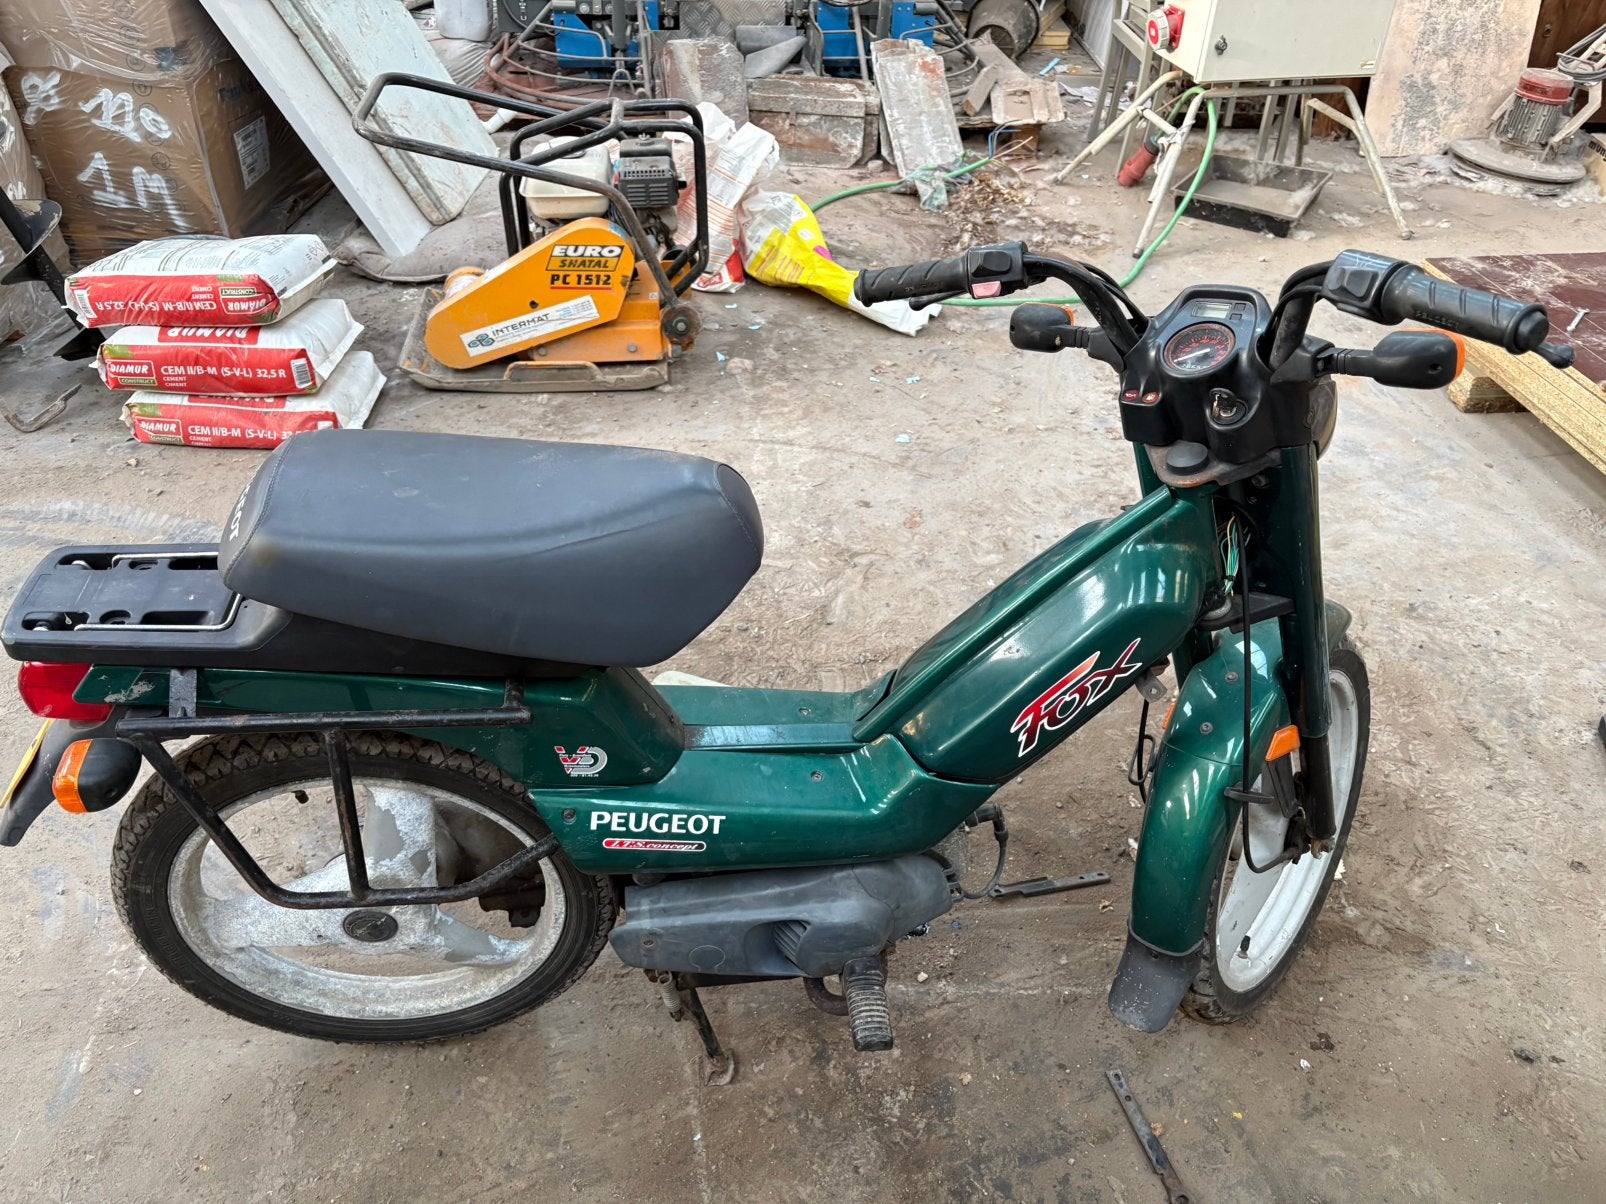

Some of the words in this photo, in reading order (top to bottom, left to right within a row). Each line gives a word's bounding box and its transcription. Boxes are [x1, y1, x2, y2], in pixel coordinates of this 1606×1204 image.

[551, 245, 622, 257] EURO
[558, 259, 609, 268] SHATAL
[550, 274, 570, 285] PC
[577, 274, 611, 285] 1512
[95, 301, 105, 311] R
[193, 301, 217, 311] CEM
[227, 298, 267, 311] DIAMUR
[491, 312, 551, 337] INTERMAT
[110, 363, 148, 374] DIAMUR
[160, 365, 186, 375] CEM
[187, 366, 217, 376] II/B-M
[221, 367, 252, 378] (S-V-L)
[256, 368, 277, 379] 32,5
[278, 369, 286, 378] R
[140, 421, 177, 432] DIAMUR
[187, 425, 211, 436] CEM
[212, 426, 242, 437] II/B-M
[245, 429, 277, 440] (S-V-L)
[1010, 637, 1142, 757] FOX
[590, 811, 726, 834] PEUGEOT
